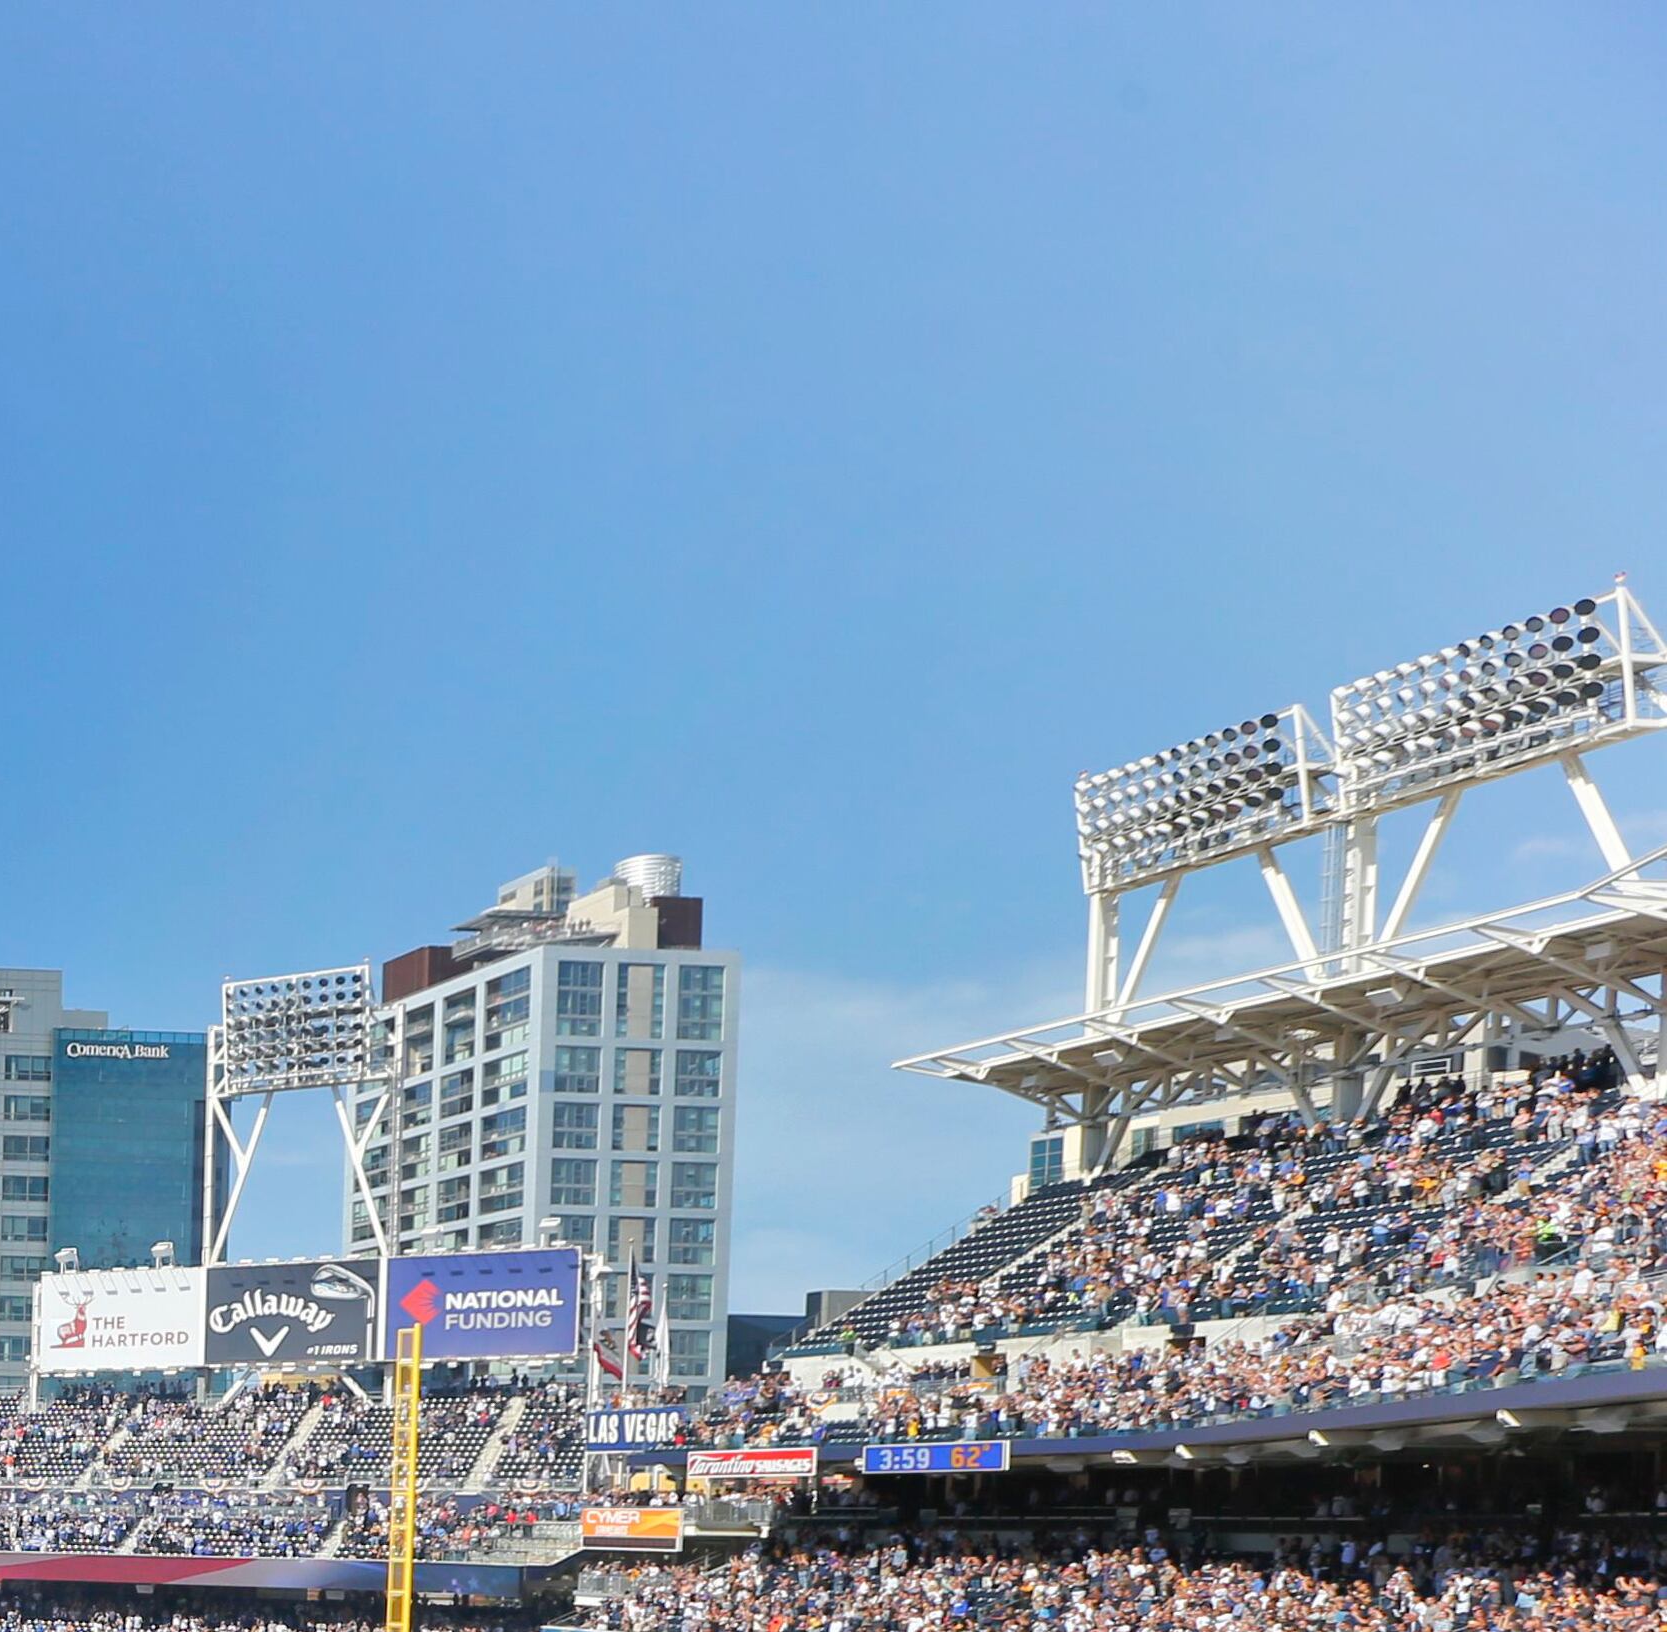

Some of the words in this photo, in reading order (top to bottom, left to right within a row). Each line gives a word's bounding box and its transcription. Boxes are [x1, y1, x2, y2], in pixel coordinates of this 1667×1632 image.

[134, 1044, 169, 1058] Bank
[445, 1288, 564, 1311] NATIONAL
[209, 1288, 335, 1334] Callaway
[445, 1310, 552, 1330] FUNDING
[92, 1316, 125, 1330] THE
[91, 1331, 188, 1348] HARTFORD
[321, 1344, 358, 1355] IRONS
[588, 1414, 618, 1444] LAS
[623, 1411, 679, 1443] VEGAS
[687, 1453, 755, 1474] Tarantino
[879, 1448, 930, 1470] 3:59
[586, 1510, 641, 1524] CYMER
